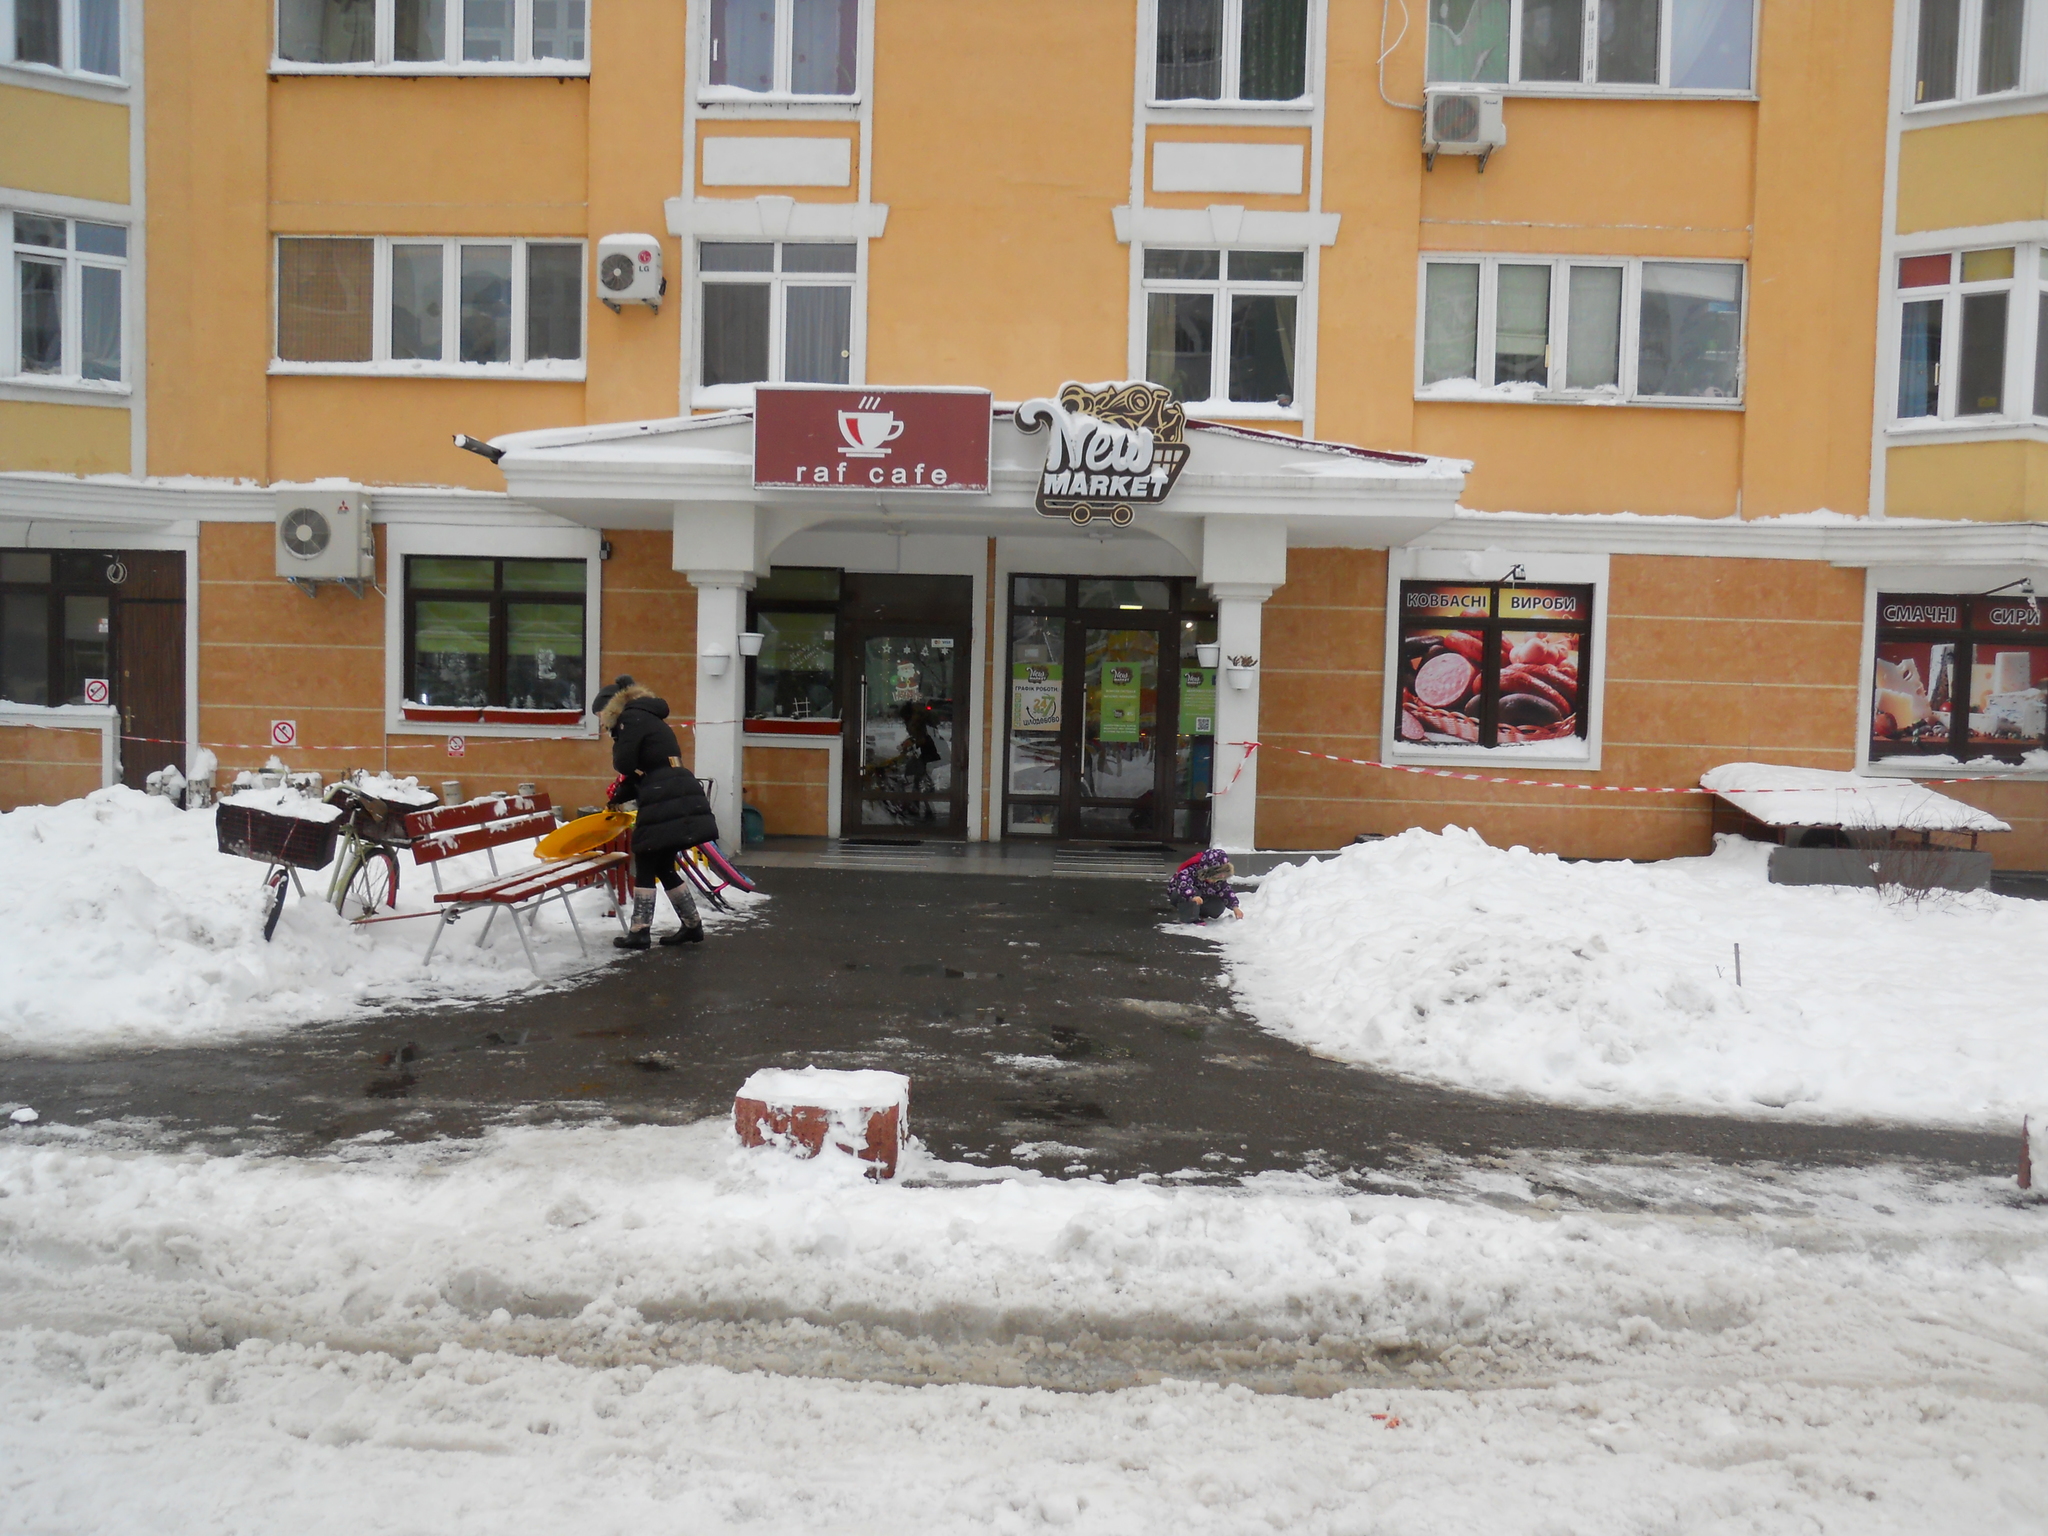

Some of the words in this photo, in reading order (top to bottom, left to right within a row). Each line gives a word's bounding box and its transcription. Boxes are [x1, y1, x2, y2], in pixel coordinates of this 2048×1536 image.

[1018, 398, 1154, 474] New
[796, 462, 848, 482] raf
[868, 463, 948, 485] cafe
[1043, 471, 1169, 497] MARKET
[1406, 593, 1487, 608] КОВБАСНІ
[1510, 596, 1577, 611] ВИРОБИ
[1883, 604, 1957, 623] СМАЧНІ
[1989, 608, 2041, 625] СИРИ
